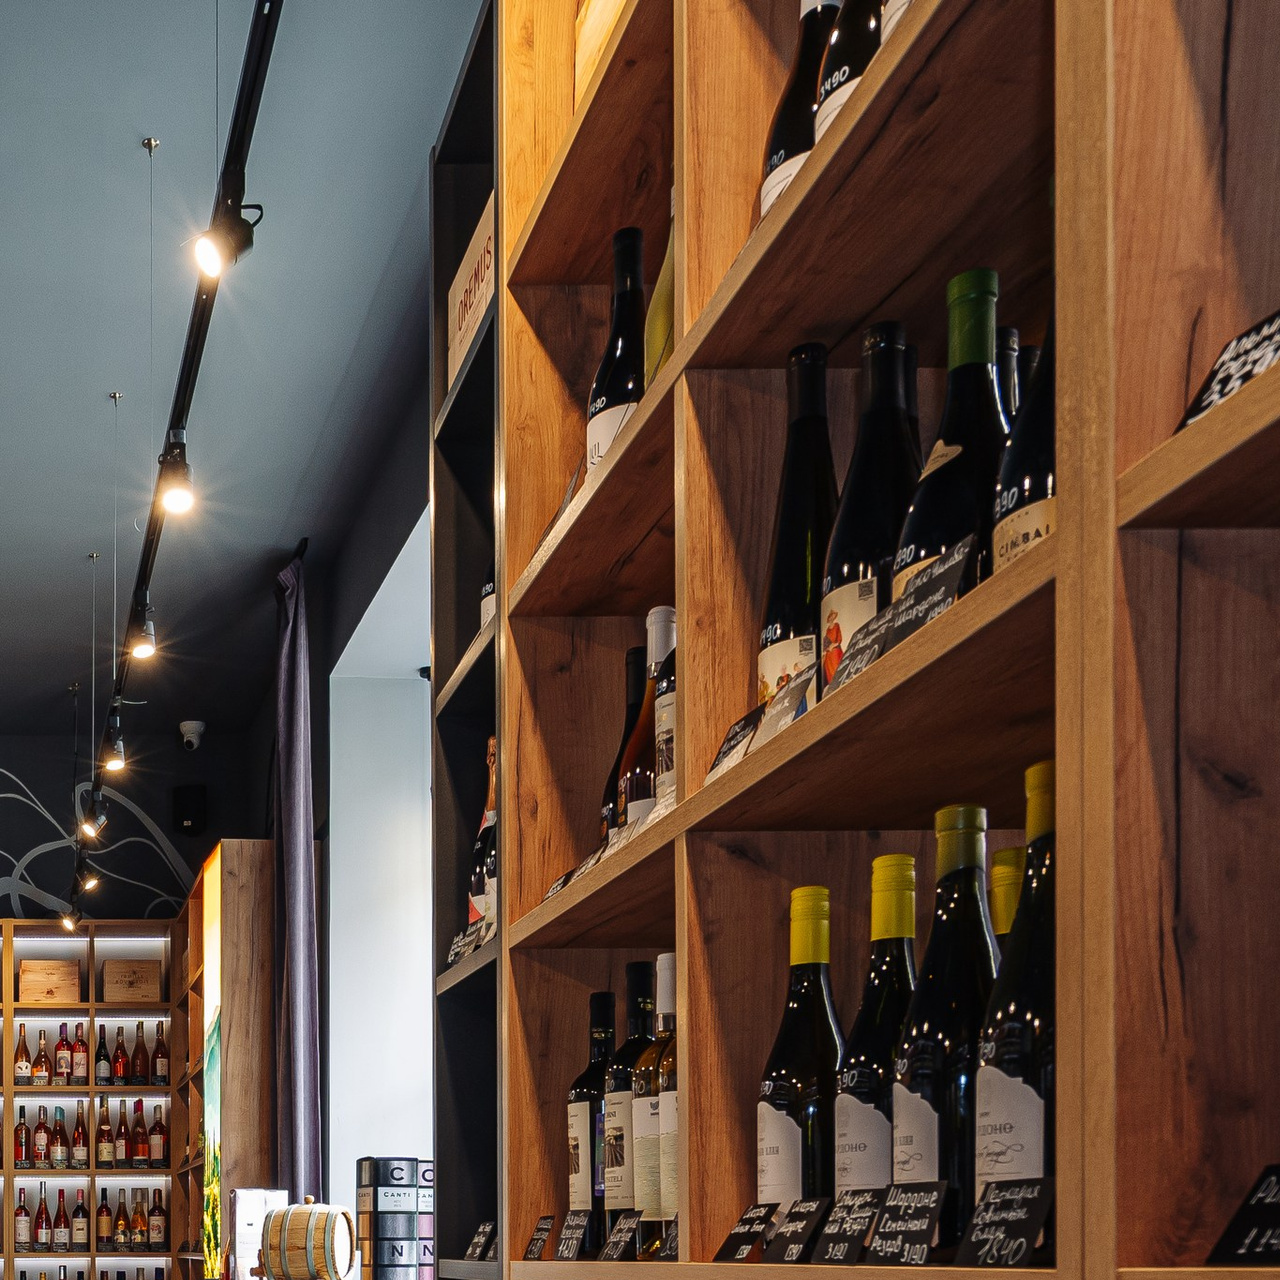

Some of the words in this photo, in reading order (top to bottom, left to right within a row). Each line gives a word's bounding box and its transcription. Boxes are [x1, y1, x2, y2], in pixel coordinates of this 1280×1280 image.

[458, 235, 492, 331] OREMUS
[389, 1166, 405, 1182] C
[885, 1186, 938, 1215] Шардоне
[878, 1213, 929, 1232] Семейный
[391, 1245, 403, 1257] N
[825, 1243, 848, 1259] 3190
[870, 1234, 902, 1256] Резерв
[900, 1243, 927, 1264] 3190
[977, 1238, 1027, 1265] 1840
